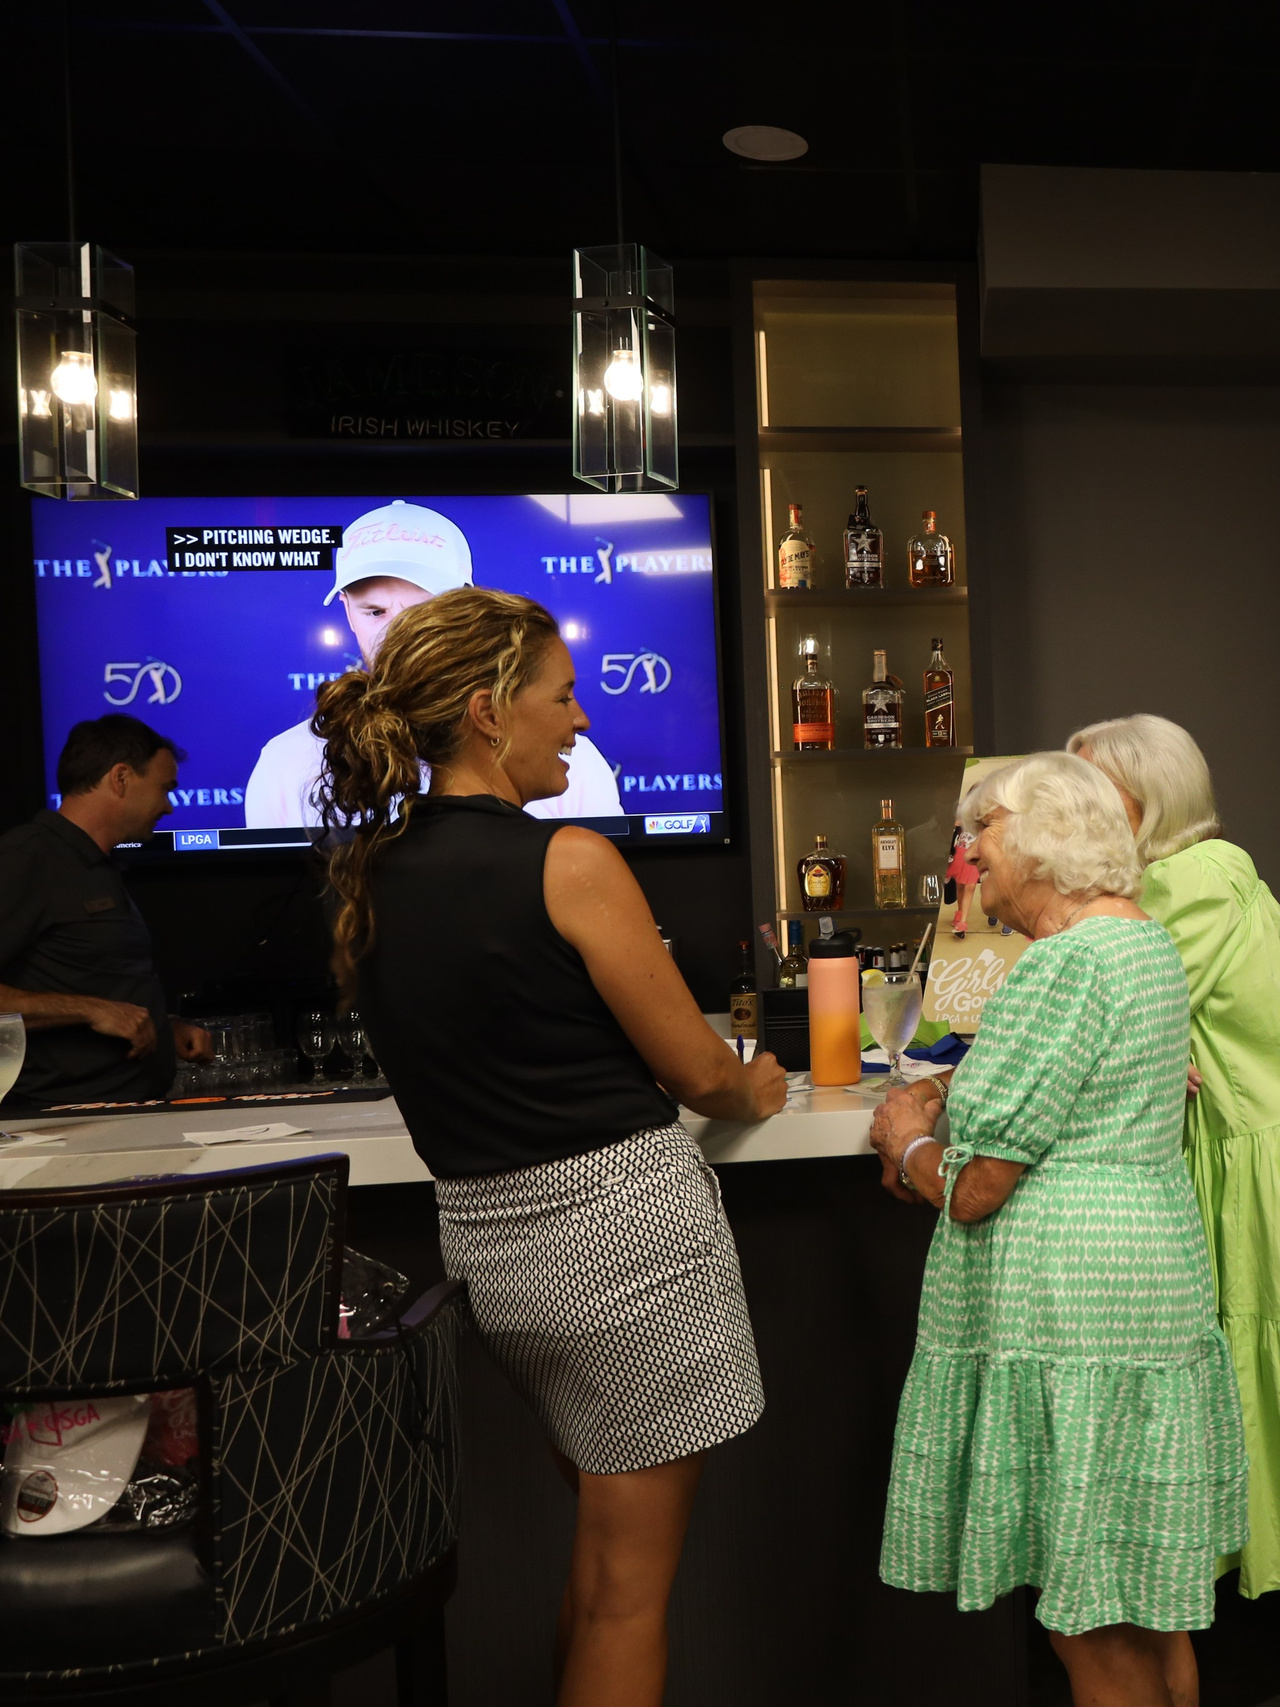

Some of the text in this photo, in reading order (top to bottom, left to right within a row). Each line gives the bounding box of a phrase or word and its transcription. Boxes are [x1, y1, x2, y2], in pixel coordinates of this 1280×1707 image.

[331, 415, 520, 438] IRISH WHISKEY
[203, 529, 274, 545] PITCHING
[278, 528, 335, 544] WEDGE.
[175, 551, 320, 568] I DON'T KNOW WHAT
[541, 556, 595, 574] THE
[34, 559, 93, 578] THE
[664, 819, 693, 830] GOLF
[181, 833, 213, 846] LPGA
[731, 998, 753, 1007] Tito's
[44, 1402, 101, 1432] USGA
